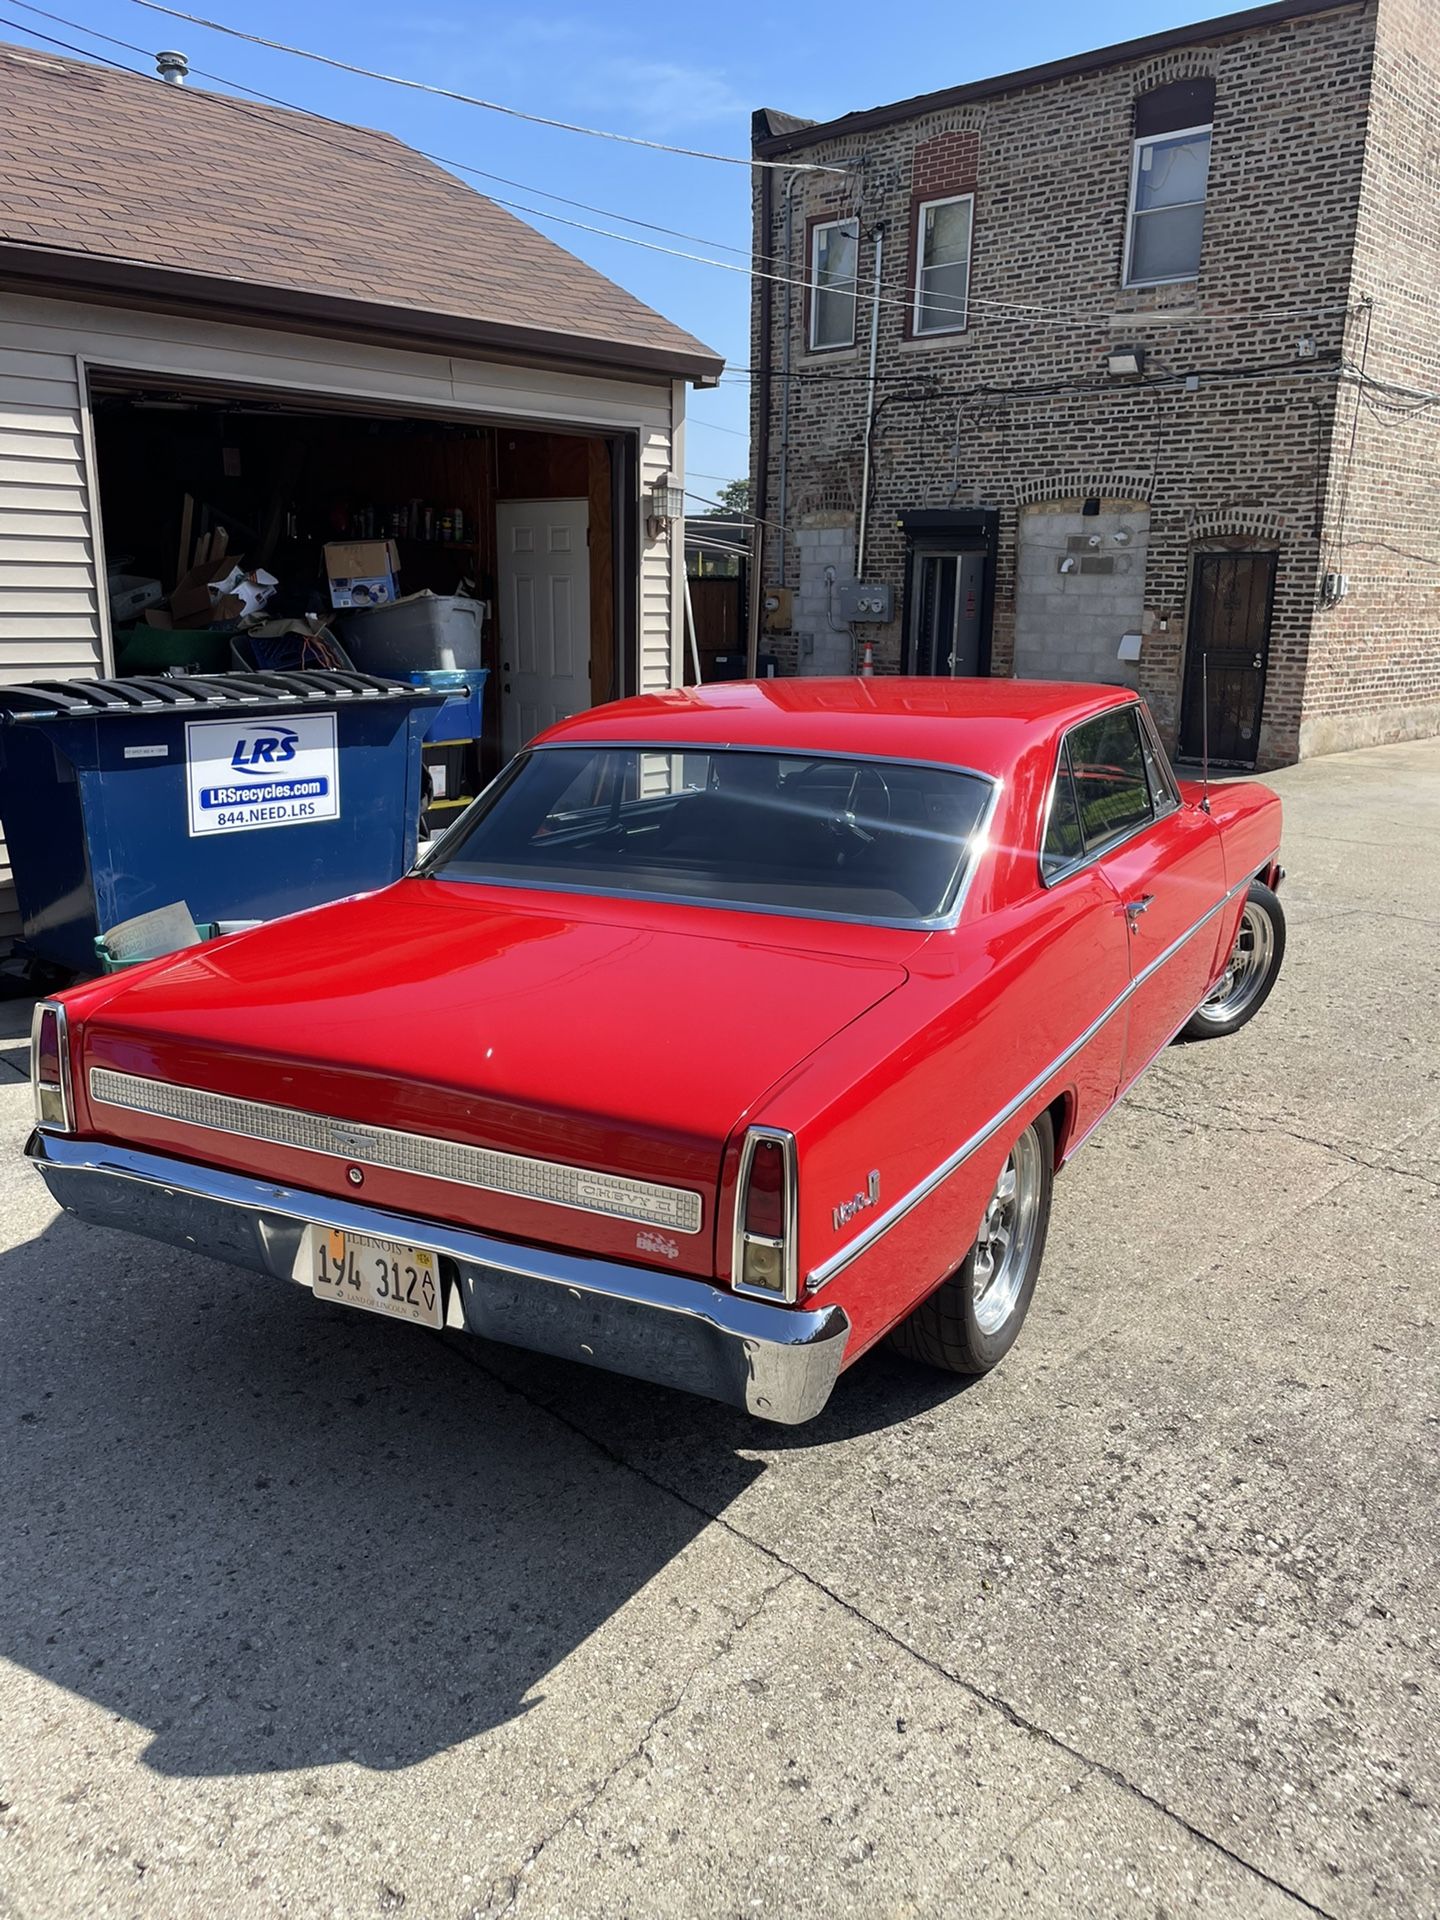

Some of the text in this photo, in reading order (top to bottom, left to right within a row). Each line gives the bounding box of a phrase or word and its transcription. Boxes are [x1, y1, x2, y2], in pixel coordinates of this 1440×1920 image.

[231, 736, 299, 765] LRS
[210, 782, 320, 804] LRSrecycles.com
[218, 802, 315, 825] 844.NEED.LRS
[582, 1185, 651, 1207] CHEVY
[347, 1233, 402, 1255] ILLINOIS
[636, 1237, 679, 1259] Bleep
[318, 1244, 419, 1306] 194 312
